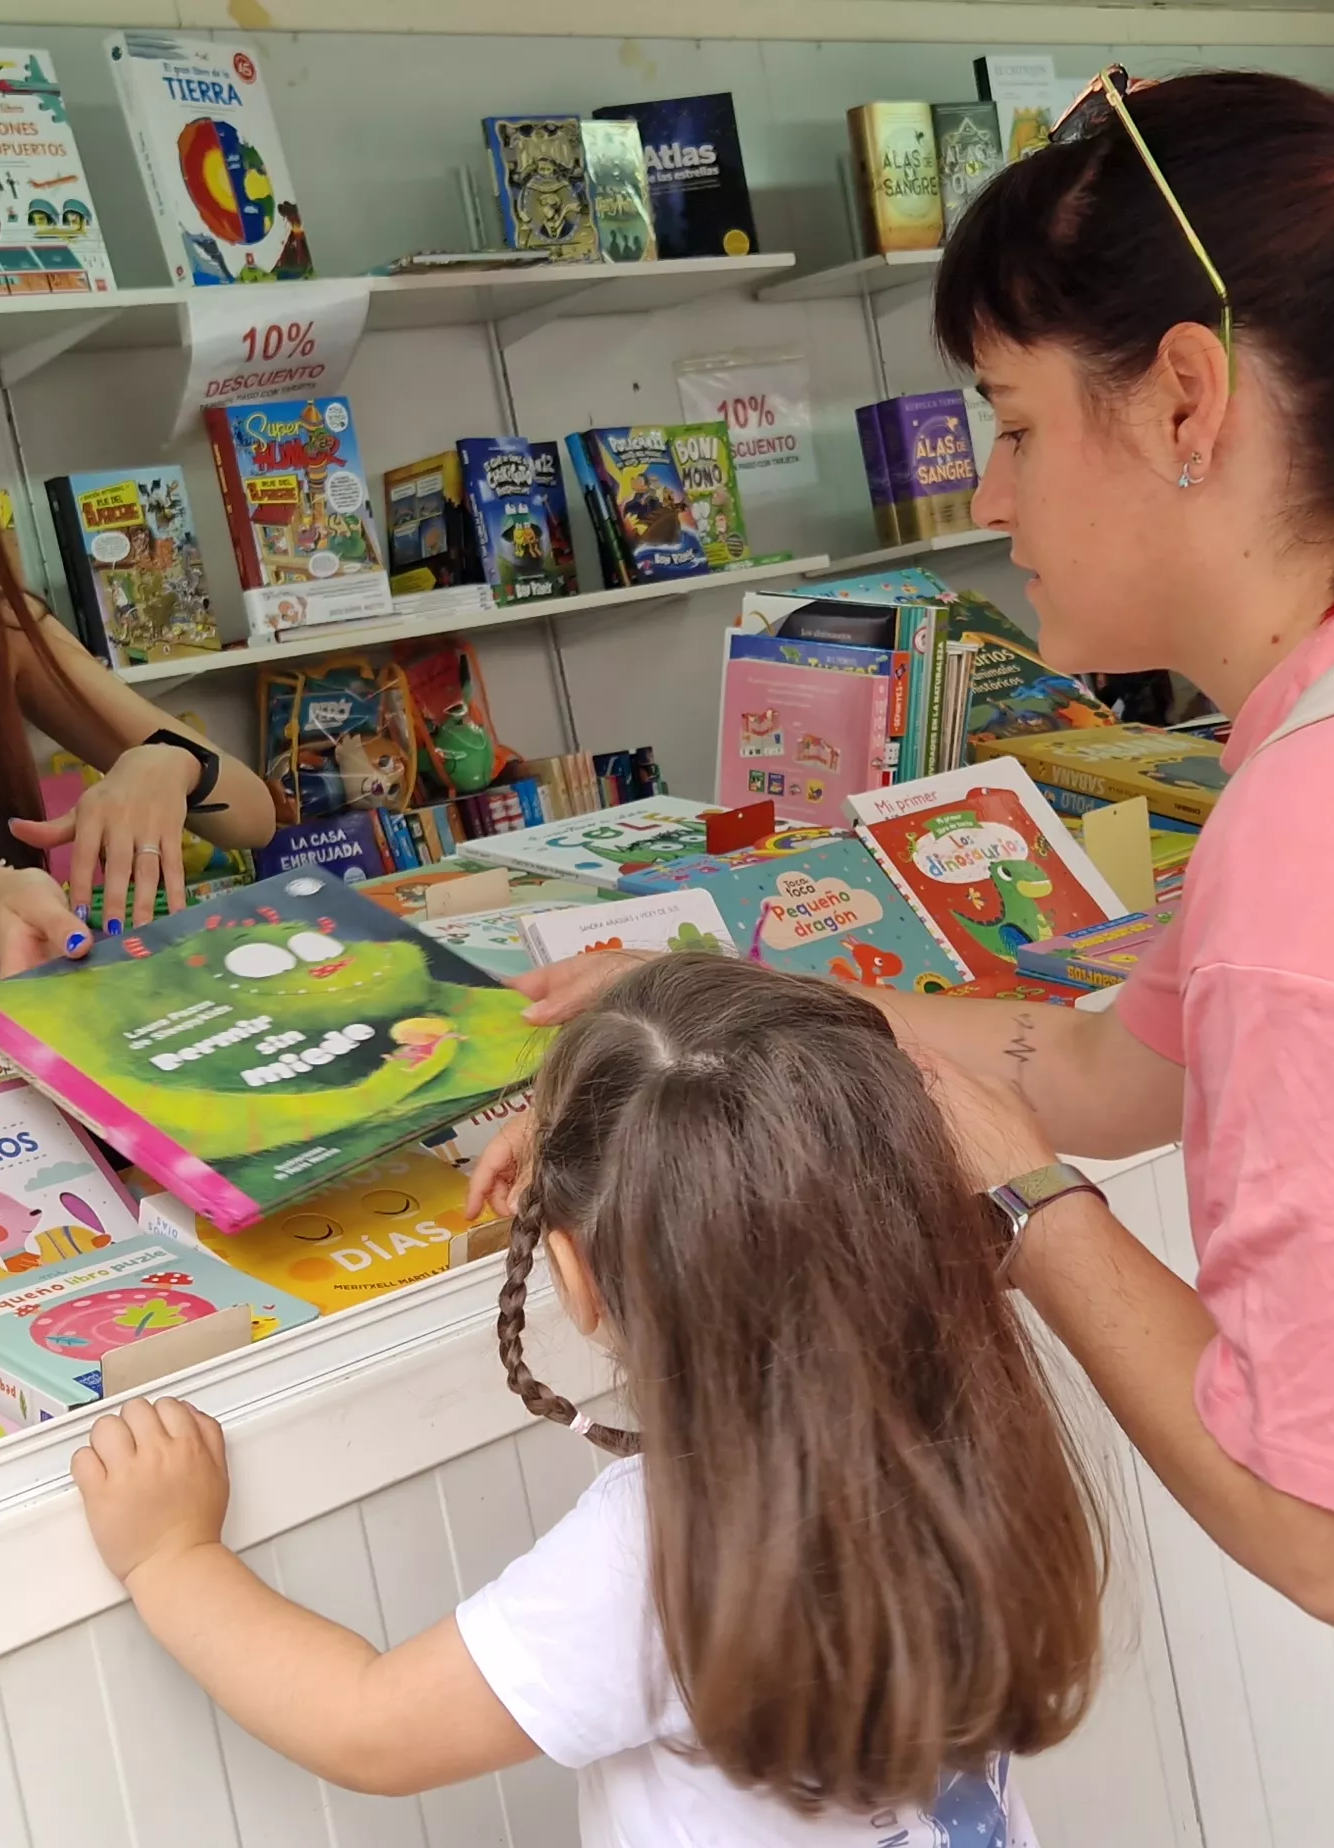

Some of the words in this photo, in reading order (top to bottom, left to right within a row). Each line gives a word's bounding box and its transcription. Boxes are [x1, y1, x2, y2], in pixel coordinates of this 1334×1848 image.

[162, 76, 244, 106] TIERRA
[643, 142, 717, 172] Atlas
[882, 150, 922, 170] ALAS
[674, 164, 720, 180] estrellas
[882, 175, 939, 198] SANGRE
[241, 320, 318, 364] 10%
[204, 363, 327, 399] DESCUENTO
[716, 394, 776, 429] 10%
[246, 411, 303, 454] Super
[730, 434, 797, 459] SCUENTO
[916, 434, 957, 459] ALAS
[674, 436, 719, 466] BONI
[682, 463, 723, 489] MONO
[917, 459, 974, 486] SANGRE
[933, 641, 946, 703] NATURALEZA
[1052, 765, 1106, 794] SABANA
[874, 798, 896, 816] Mi
[897, 790, 938, 813] primer
[1061, 791, 1096, 811] POLO
[290, 836, 309, 851] LA
[309, 827, 348, 847] CASA
[949, 834, 974, 850] Los
[926, 837, 1027, 878] dinosaurios
[782, 877, 808, 888] Toca
[785, 885, 817, 899] toca
[770, 889, 852, 922] Pequeño
[793, 909, 858, 939] dragón
[148, 1014, 274, 1072] Dormir
[239, 1022, 376, 1088] miedo
[255, 1030, 308, 1056] sin
[329, 1218, 455, 1274] DÍAS
[62, 1267, 109, 1289] libro
[108, 1247, 167, 1276] puzle
[333, 1280, 397, 1292] MERITXELL
[397, 1271, 430, 1287] MARTÍ
